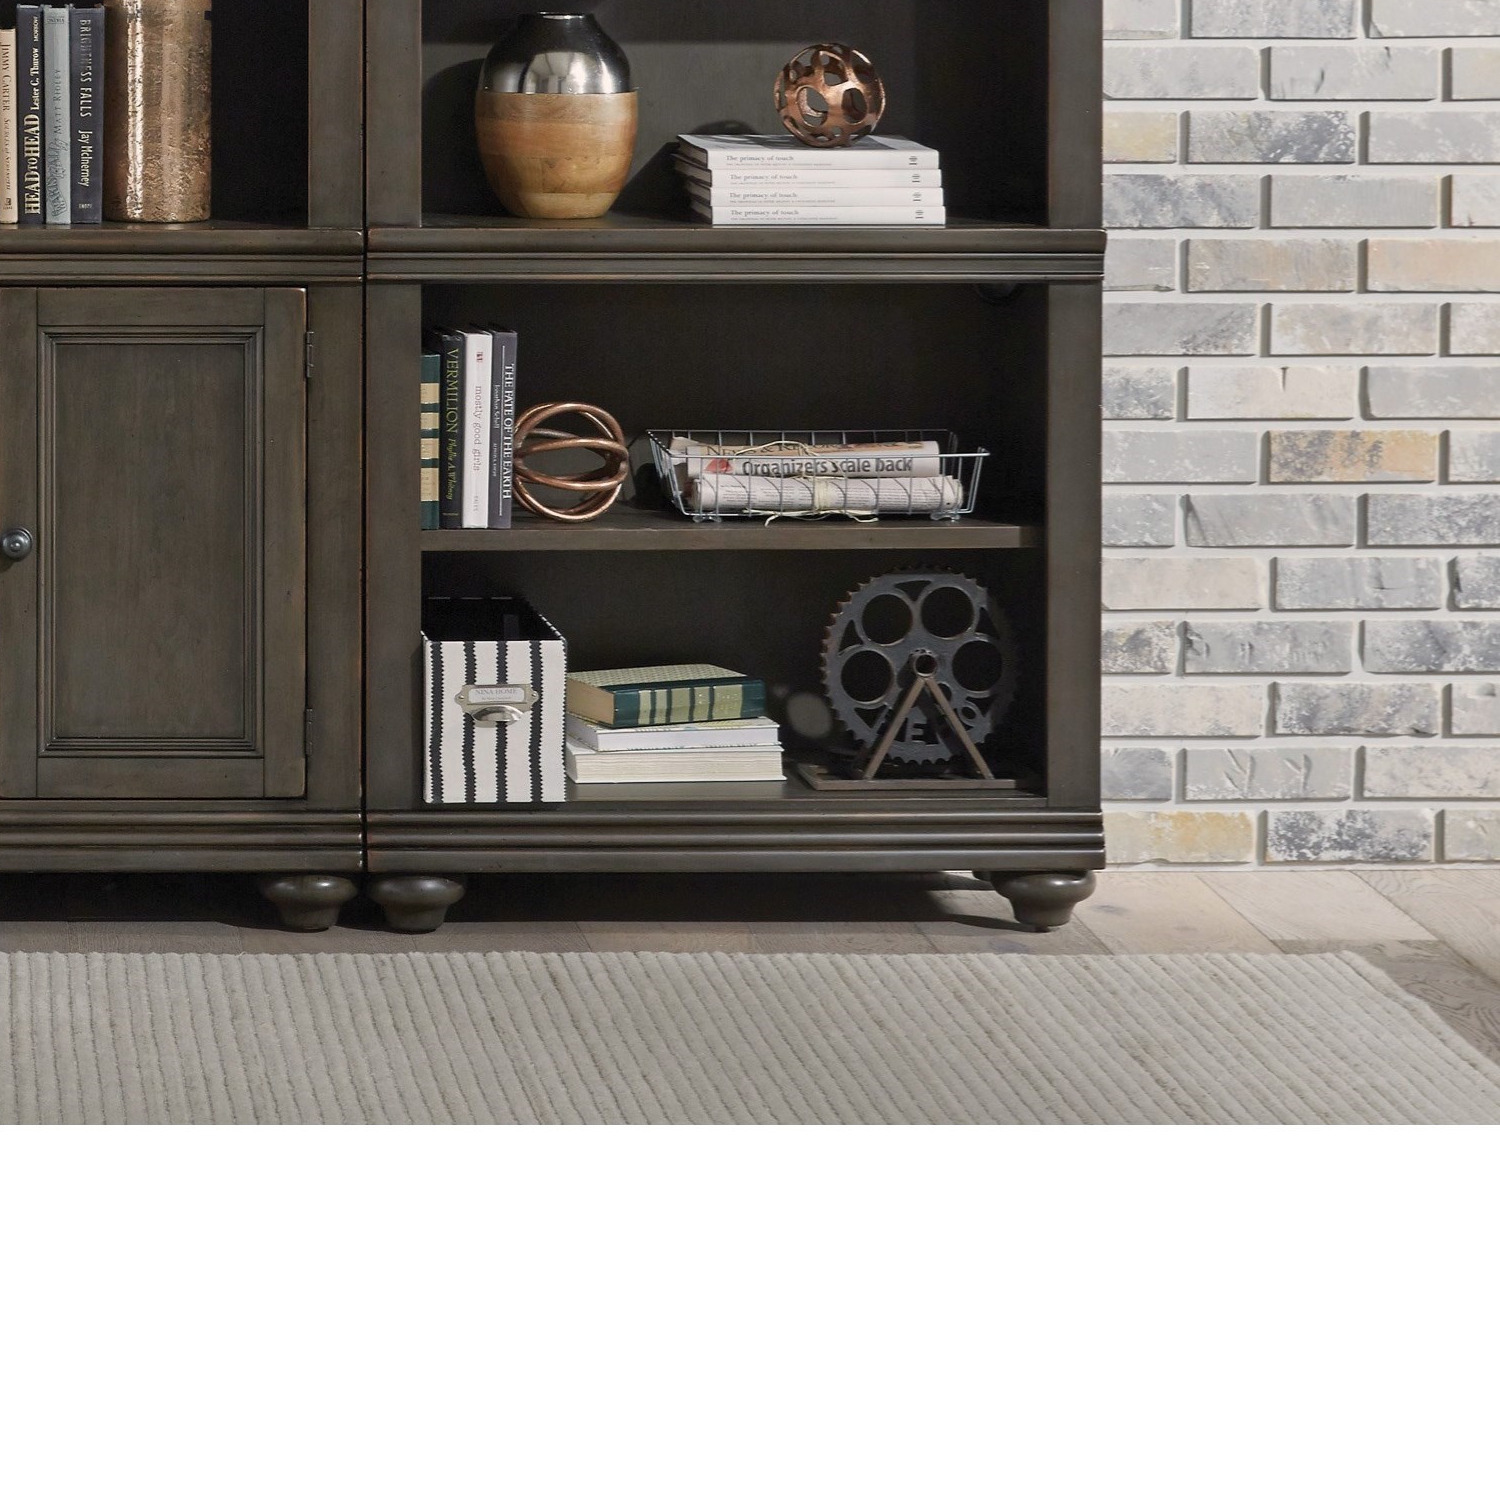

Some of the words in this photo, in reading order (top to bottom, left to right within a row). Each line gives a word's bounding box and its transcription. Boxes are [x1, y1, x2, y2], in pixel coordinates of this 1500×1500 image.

[0, 42, 12, 71] JIMMY
[30, 48, 39, 76] Thurow
[2, 75, 12, 111] CARTER
[30, 78, 39, 86] C.
[53, 69, 62, 101] RIDLEY
[30, 88, 39, 110] Lester
[80, 88, 92, 117] FALLS
[78, 130, 93, 144] Jay
[78, 145, 93, 187] McInerney
[504, 364, 514, 387] THE
[446, 348, 459, 433] VERMILION
[473, 386, 482, 419] mostly
[504, 390, 514, 415] FATE
[473, 422, 482, 445] good
[504, 418, 513, 433] OF
[472, 449, 482, 471] girls
[504, 436, 512, 458] THE
[503, 461, 512, 499] EARTH
[742, 458, 828, 476] Organizers
[831, 460, 870, 473] scale
[875, 458, 914, 472] back
[446, 471, 457, 500] Whitney
